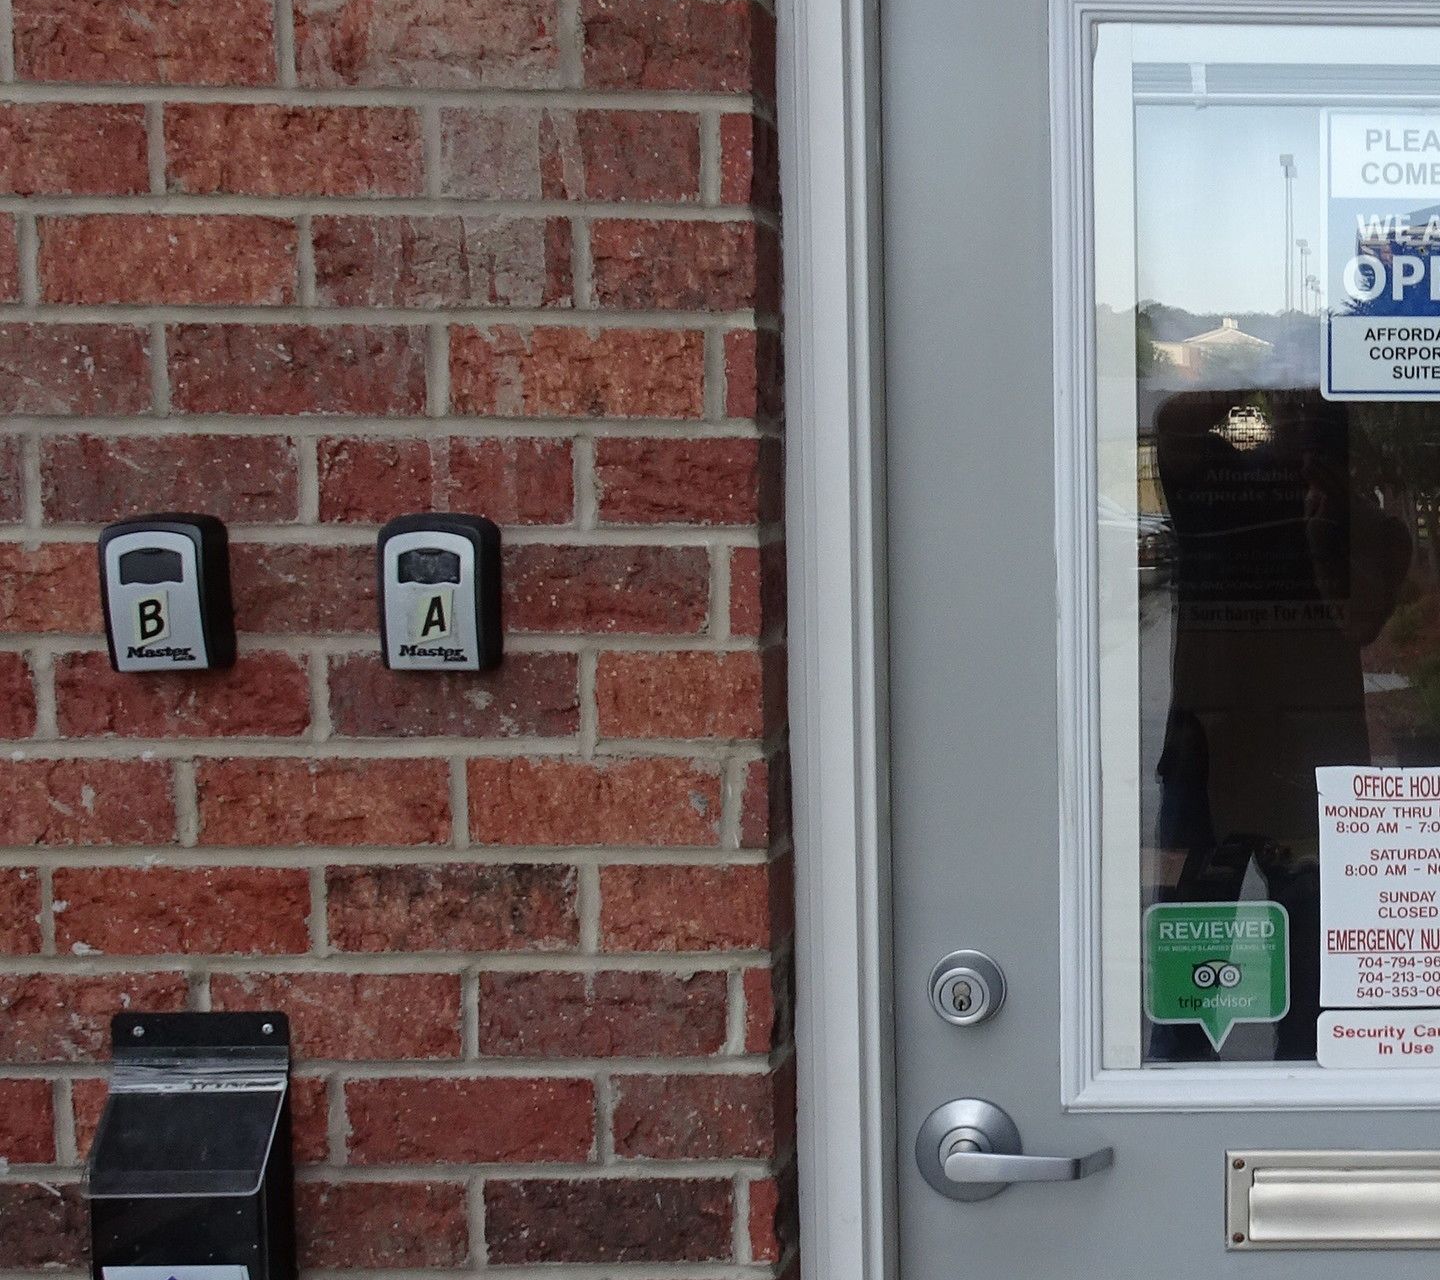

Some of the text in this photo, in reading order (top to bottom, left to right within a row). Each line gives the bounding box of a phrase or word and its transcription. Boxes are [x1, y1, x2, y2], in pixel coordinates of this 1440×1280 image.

[1356, 214, 1411, 243] WE
[139, 598, 165, 641] B
[421, 596, 448, 637] A
[127, 646, 192, 659] Master
[399, 645, 464, 657] Master
[1353, 775, 1404, 798] OFFICE
[1325, 806, 1386, 818] MONDAY
[1392, 806, 1432, 818] THRU
[1336, 822, 1369, 833] 8:00
[1376, 822, 1398, 834] AM
[1345, 864, 1378, 876] 8:00
[1385, 864, 1407, 876] AM
[1379, 891, 1436, 903] SUNDAY
[1378, 906, 1439, 919] CLOSED
[1160, 920, 1275, 940] REVIEWED
[1327, 928, 1415, 951] EMERGENCY
[1178, 993, 1252, 1011] tripadvisor
[1333, 1025, 1405, 1040] Security
[1378, 1042, 1434, 1054] In Use
